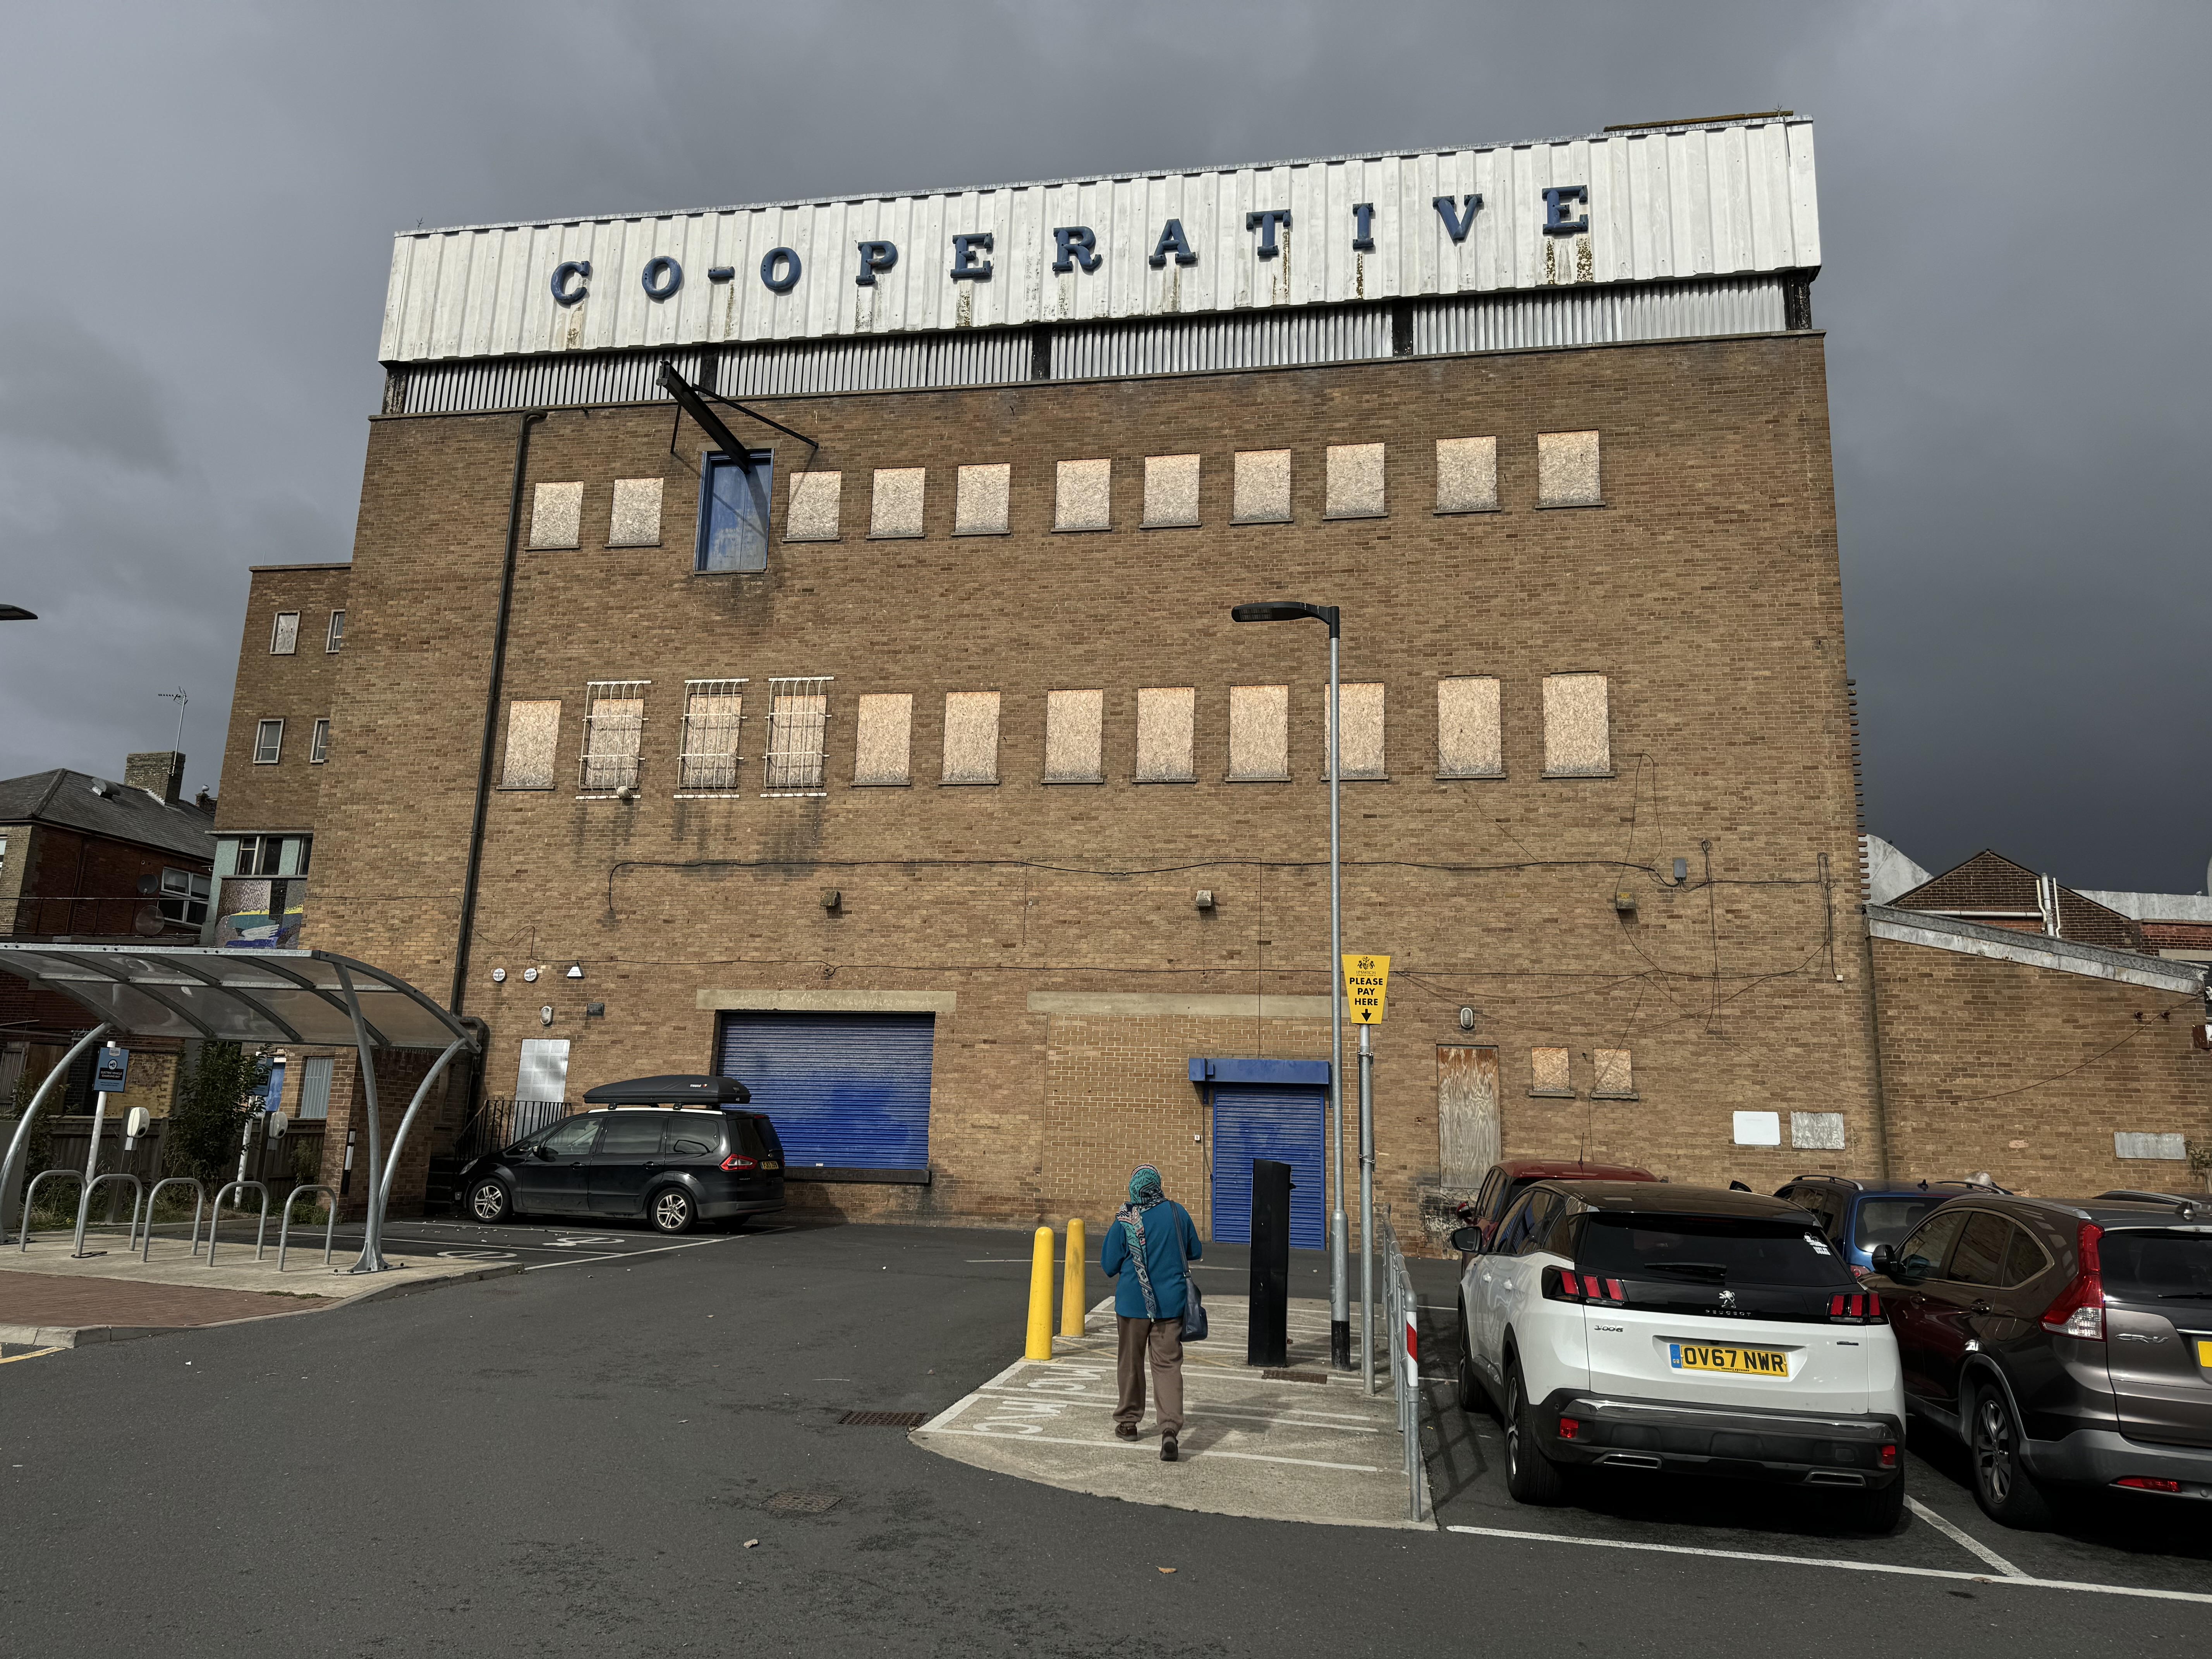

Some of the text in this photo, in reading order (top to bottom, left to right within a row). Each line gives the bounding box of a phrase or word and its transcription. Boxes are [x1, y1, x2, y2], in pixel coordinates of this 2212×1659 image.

[550, 186, 1589, 304] CO-OPERATIVE
[2115, 1333, 2169, 1344] CR-V
[1684, 1347, 1784, 1372] OV67 NWR
